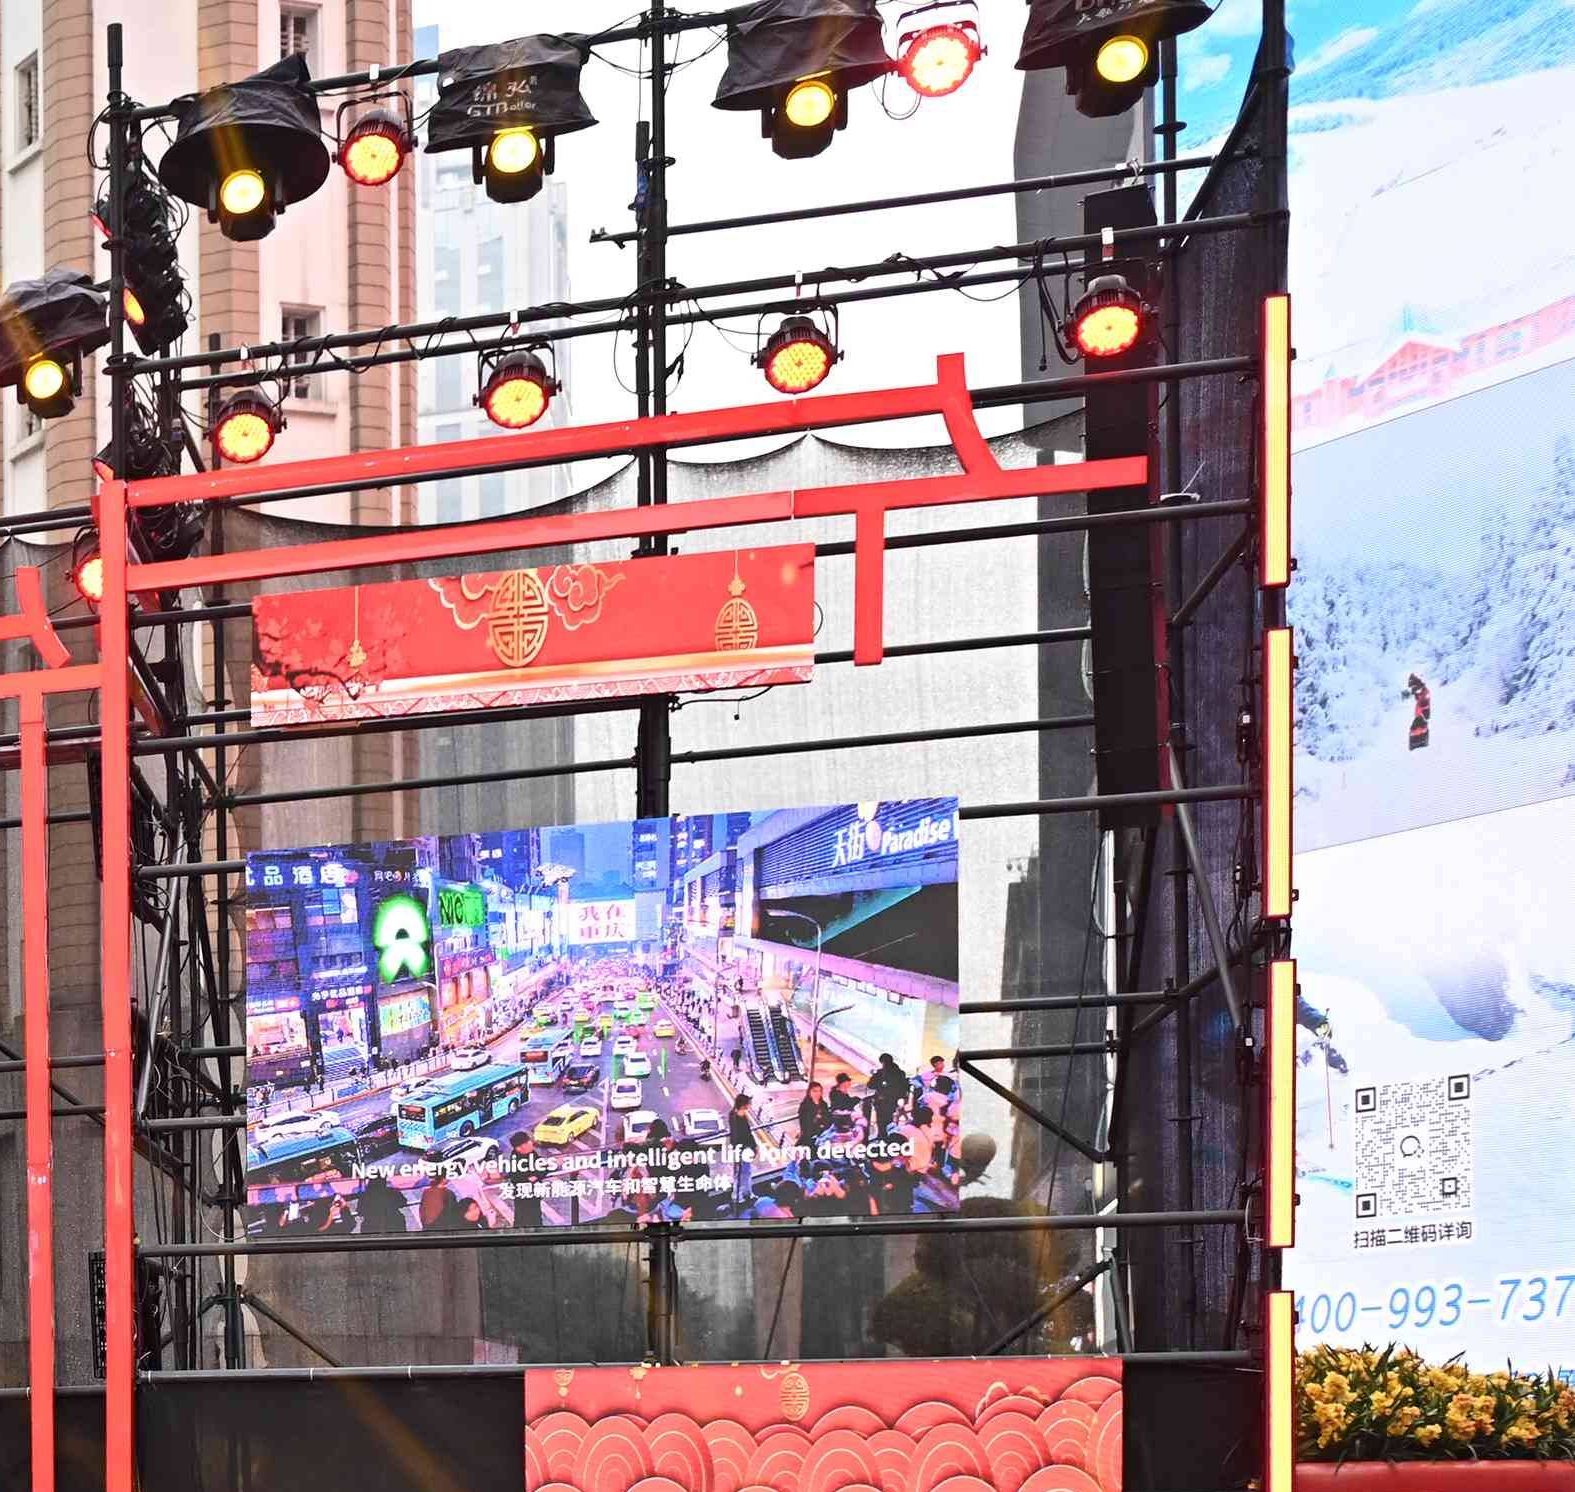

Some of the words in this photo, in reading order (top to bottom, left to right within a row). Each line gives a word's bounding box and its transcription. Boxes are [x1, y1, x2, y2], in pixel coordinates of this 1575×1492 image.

[881, 816, 951, 856] Paradise
[352, 1163, 394, 1179] New
[400, 1160, 469, 1180] energy
[474, 1153, 557, 1174] vehicles
[562, 1151, 602, 1171] and
[607, 1147, 716, 1171] intelligent
[720, 1145, 755, 1164] life
[759, 1143, 812, 1163] form
[816, 1141, 915, 1160] detected
[499, 1175, 732, 1200] 发现新能源汽车和智慧生命体
[1353, 1221, 1473, 1250] 扫描二维码详询
